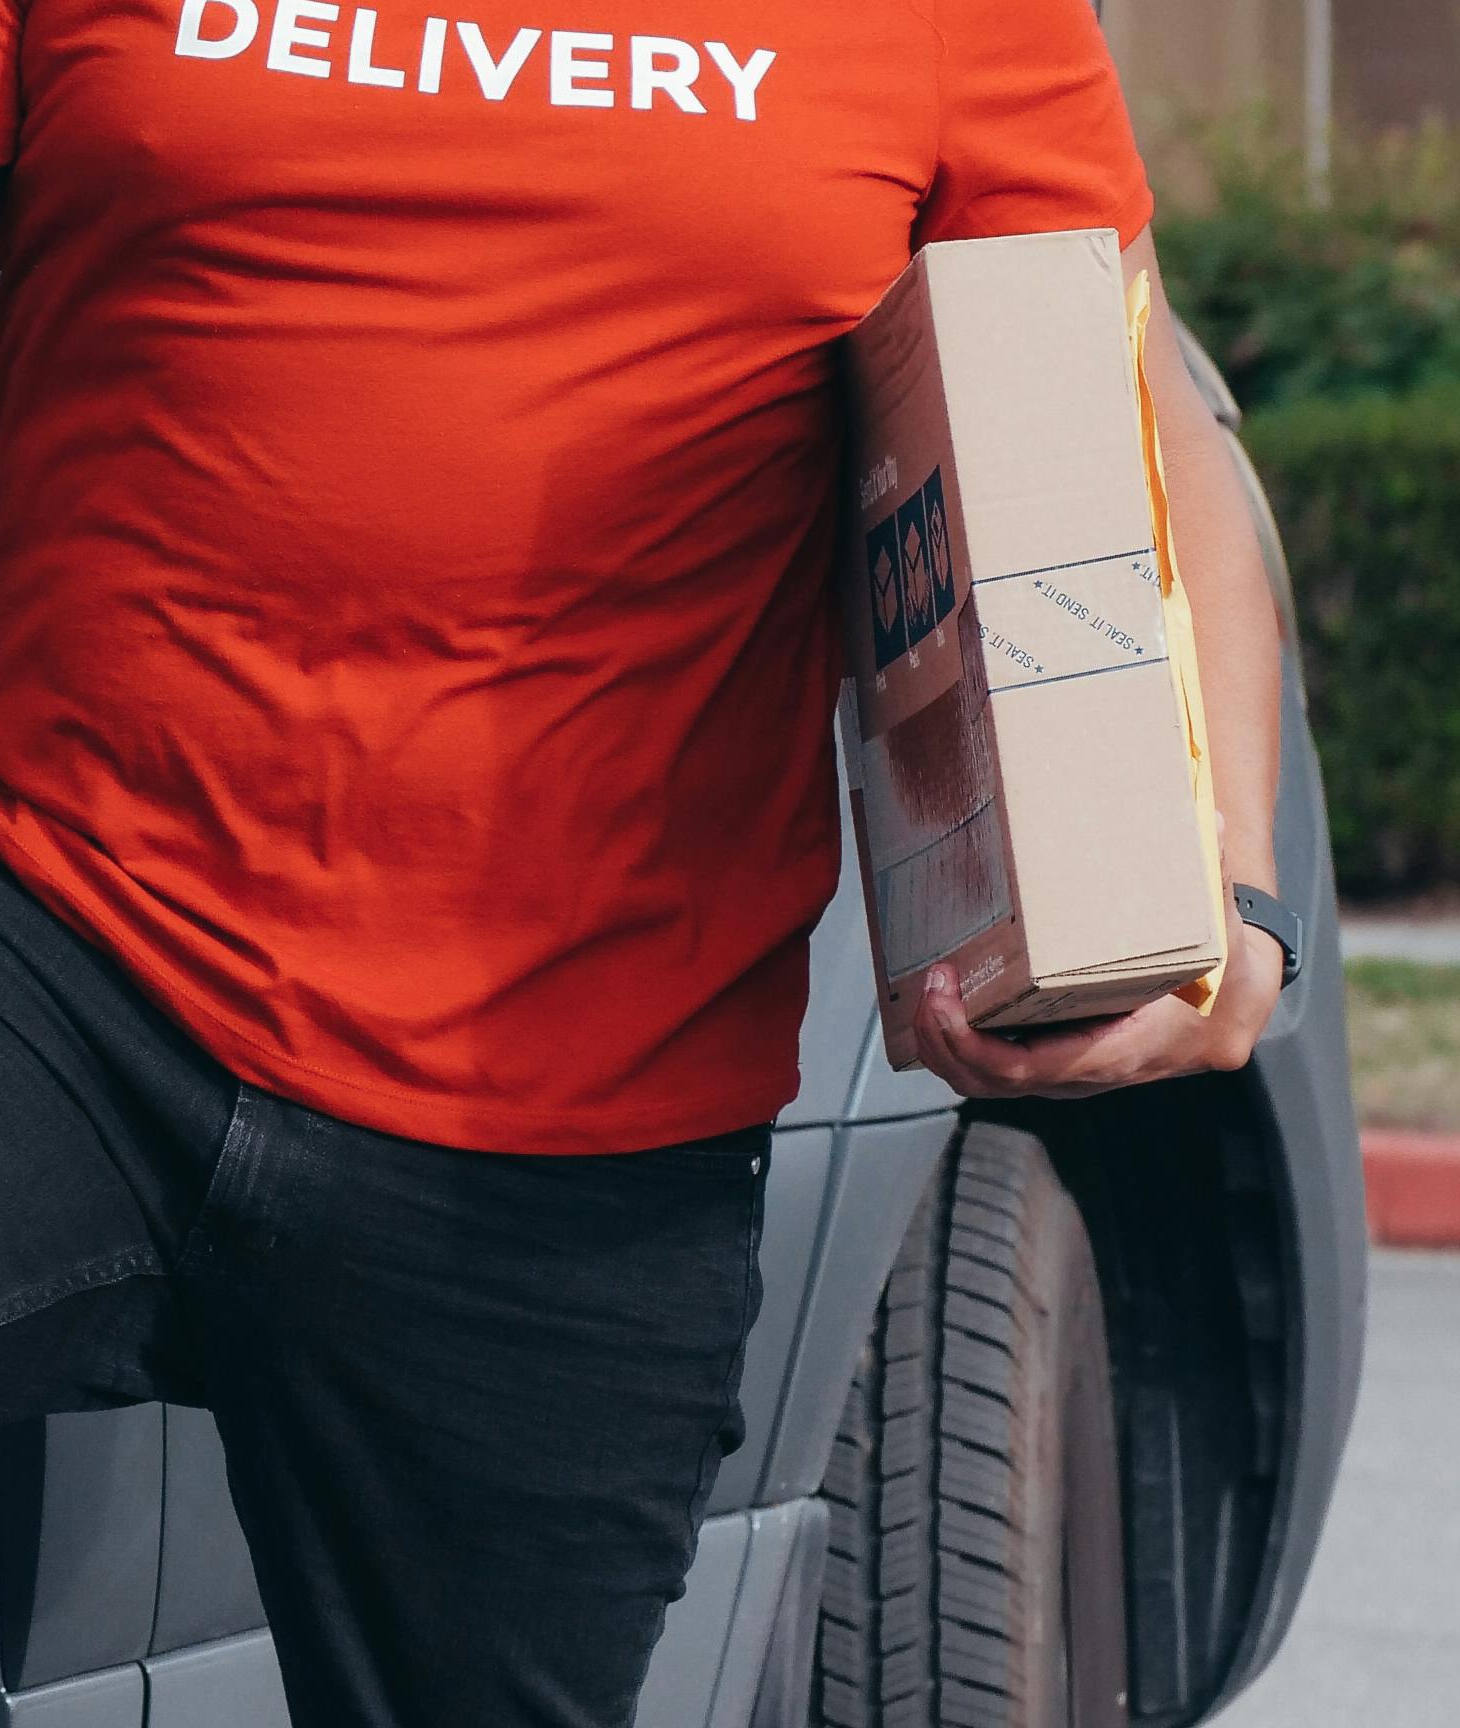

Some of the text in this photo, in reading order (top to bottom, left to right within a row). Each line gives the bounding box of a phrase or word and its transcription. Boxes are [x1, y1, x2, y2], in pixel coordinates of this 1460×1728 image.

[1055, 593, 1090, 620] SEND
[1104, 622, 1134, 650] SEAL
[1004, 641, 1034, 668] SEAL
